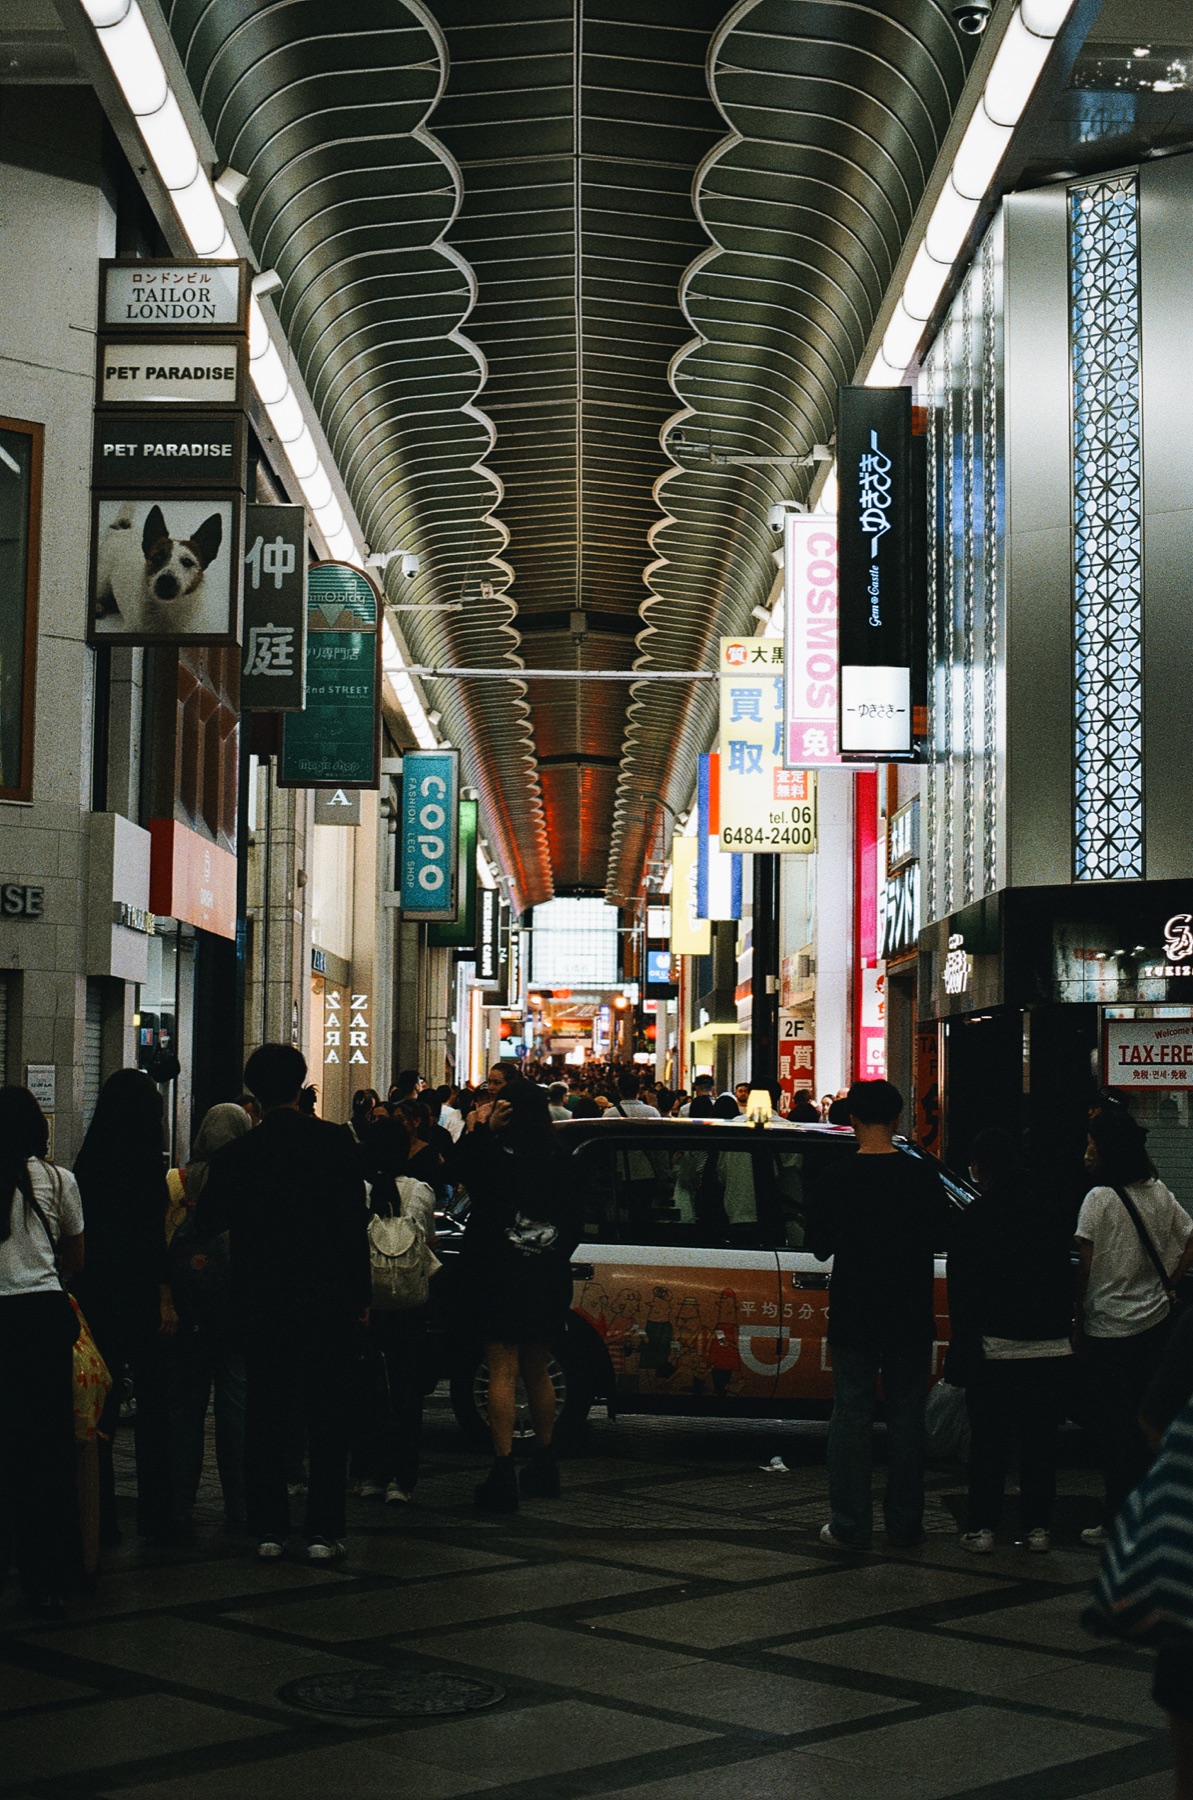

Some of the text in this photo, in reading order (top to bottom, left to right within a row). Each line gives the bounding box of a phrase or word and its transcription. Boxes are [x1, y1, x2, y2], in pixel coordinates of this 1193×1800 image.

[132, 272, 212, 284] ロンドンビル
[132, 287, 212, 303] TAILOR
[125, 303, 217, 319] LONDON
[106, 366, 235, 380] PET PARADISE
[103, 444, 233, 457] PET PARADISE
[859, 454, 892, 532] ゆきざき
[867, 564, 882, 627] Gem Castle
[244, 535, 296, 676] 仲庭
[806, 531, 838, 710] COSMOS
[305, 685, 369, 694] 2nd STREET
[728, 688, 764, 775] 買取
[776, 783, 804, 798] 無料
[409, 777, 417, 824] FASHION
[769, 806, 811, 824] tel. 06
[723, 827, 812, 845] 6484-2400
[407, 861, 415, 888] SHOP
[1144, 965, 1193, 977] YUKIZ
[349, 994, 369, 1064] ZARA
[785, 1021, 804, 1037] 2F
[1154, 1027, 1190, 1039] Welcome
